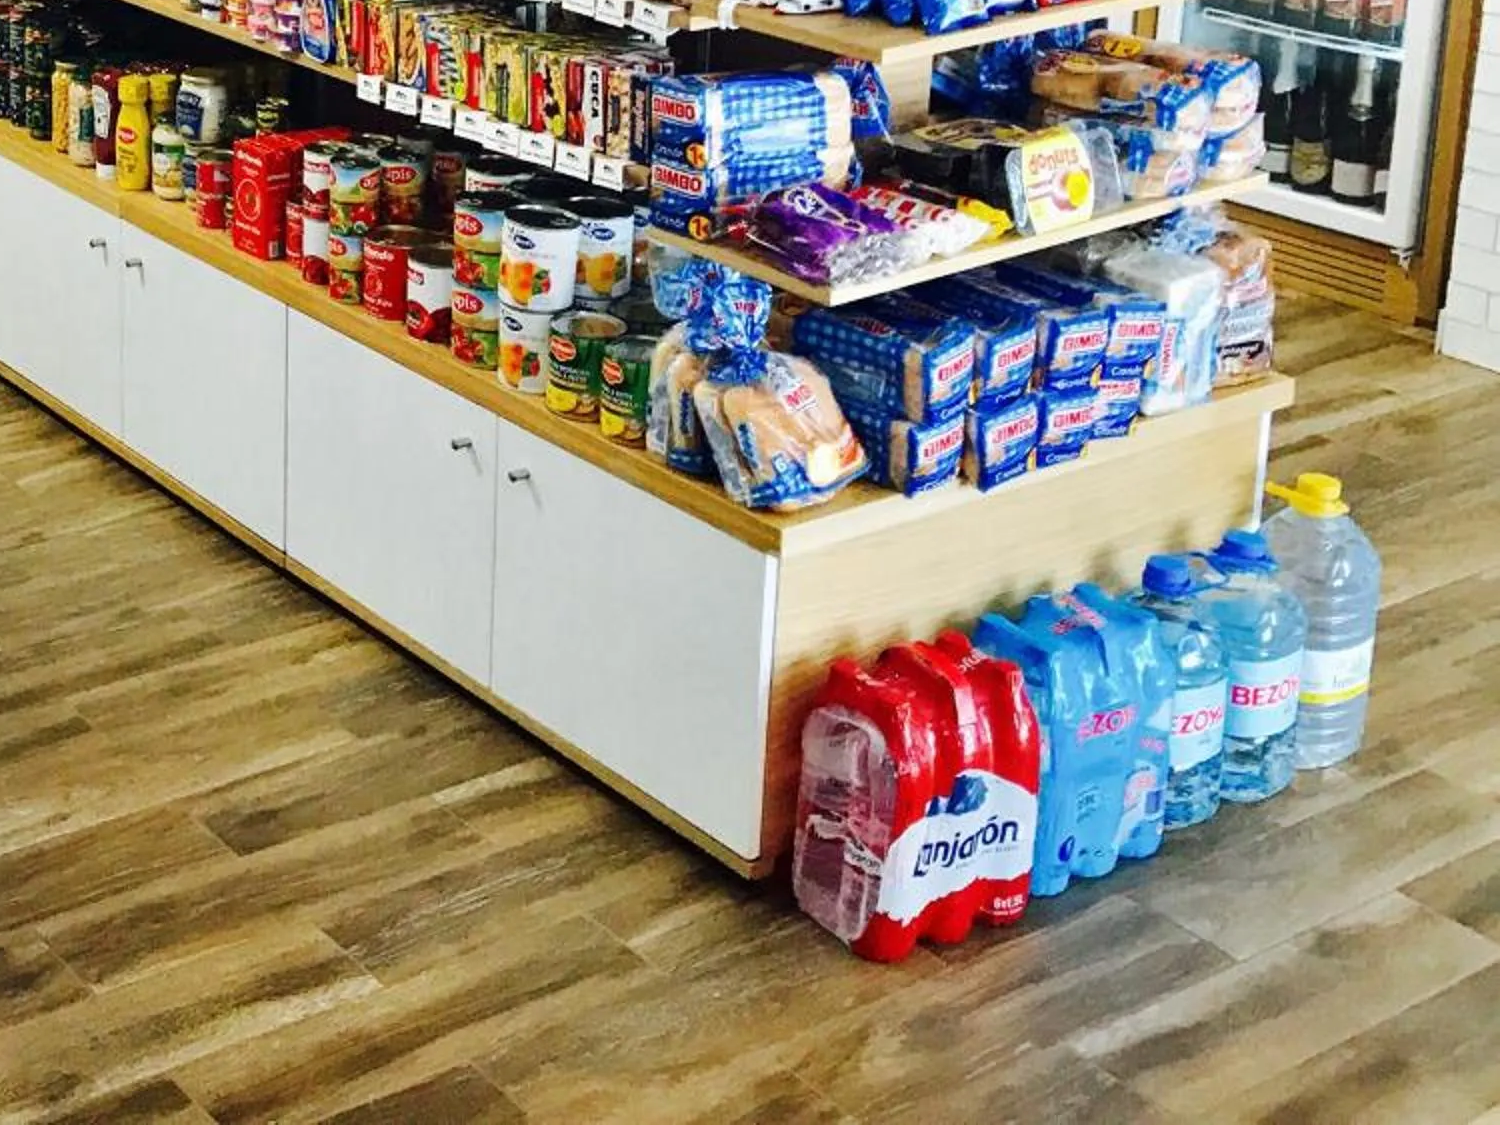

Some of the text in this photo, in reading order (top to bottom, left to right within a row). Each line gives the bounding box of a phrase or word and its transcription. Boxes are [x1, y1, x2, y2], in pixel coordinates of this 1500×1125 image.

[653, 96, 697, 122] BIMBO
[1029, 147, 1079, 173] donuts
[653, 166, 702, 193] BIMBO
[1062, 330, 1107, 352] BIMBO
[1117, 320, 1162, 336] BIMBO
[1171, 704, 1224, 736] EZOYA
